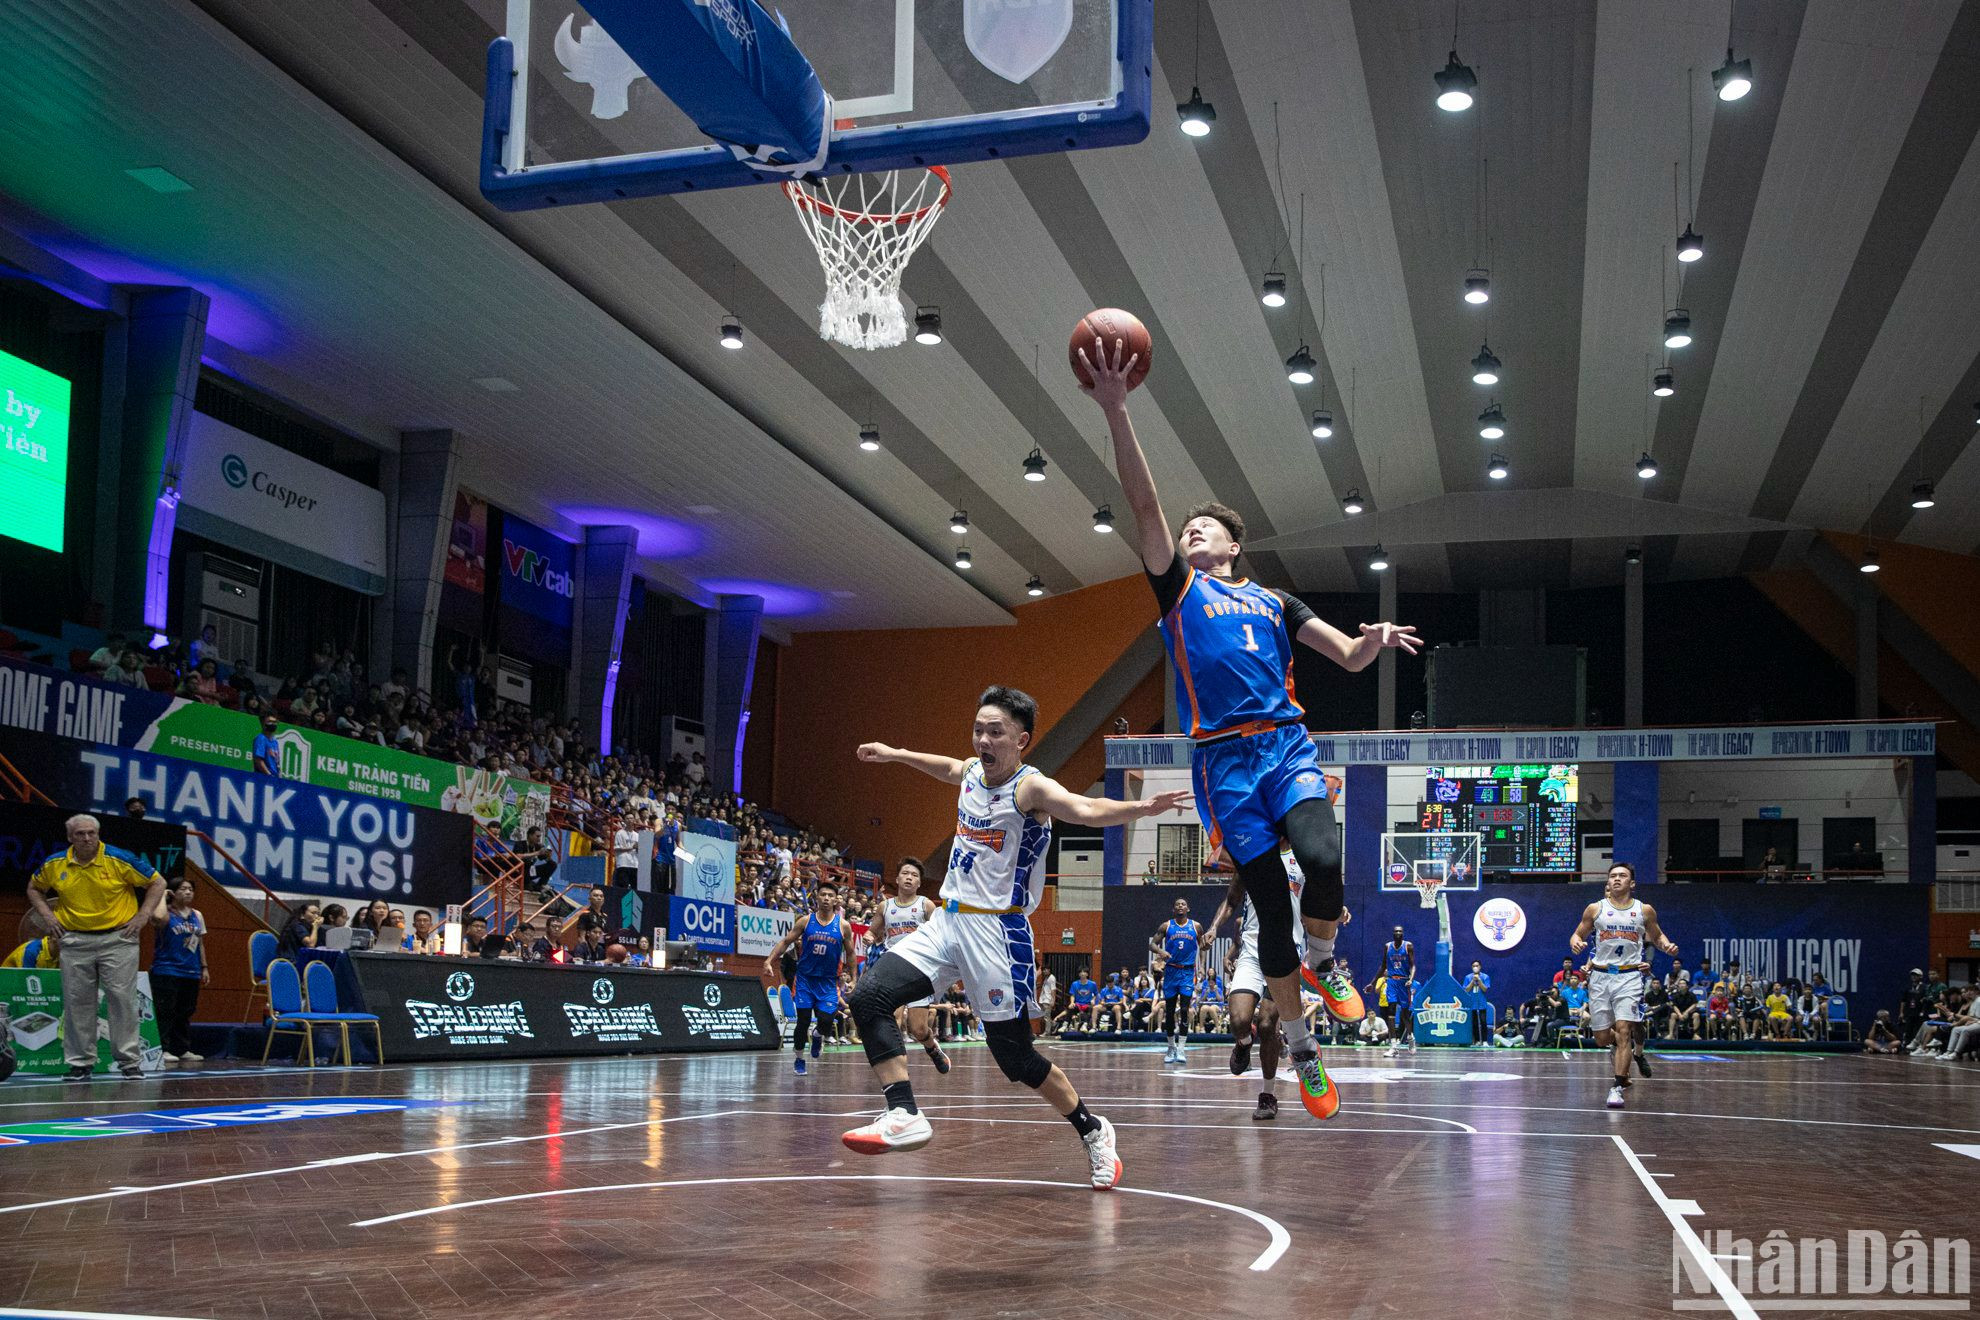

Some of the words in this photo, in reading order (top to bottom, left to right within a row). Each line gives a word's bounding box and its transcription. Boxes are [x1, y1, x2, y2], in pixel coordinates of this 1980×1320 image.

[711, 0, 754, 51] SPORT
[6, 389, 41, 428] by
[252, 471, 317, 511] Casper
[504, 538, 574, 598] VTVcab
[1242, 624, 1259, 651] 1
[57, 680, 126, 747] GAME
[171, 735, 242, 761] PRESENTED
[1315, 739, 1335, 761] OWN
[1348, 740, 1358, 761] THE
[1359, 739, 1379, 761] CAPITAL
[1381, 738, 1411, 761] LEGACY
[1427, 738, 1466, 761] REPRESENTING
[1468, 737, 1501, 760] H-TOWN
[1515, 737, 1525, 759] THE
[1526, 737, 1547, 759] CAPITAL
[1549, 735, 1580, 758] LEGACY
[1597, 735, 1637, 757] REPRESENTING
[1639, 734, 1673, 757] H-TOWN
[1687, 733, 1698, 756] THE
[1699, 732, 1720, 756] CAPITAL
[1722, 732, 1754, 755] LEGACY
[1771, 731, 1815, 754] REPRESENTING
[1815, 730, 1850, 754] H-TOWN
[1865, 729, 1877, 752] THE
[1877, 729, 1900, 752] CAPITAL
[1902, 728, 1936, 752] LEGACY
[1143, 742, 1174, 765] H-TOWN
[317, 755, 348, 776] KEM
[353, 762, 397, 786] TRÀNG
[402, 772, 431, 793] TIỀN
[81, 751, 297, 831] THANK
[318, 794, 415, 849] YOU
[348, 781, 378, 795] SINCE
[381, 787, 401, 800] 1958
[1510, 788, 1522, 802] 58
[968, 815, 993, 828] TRANG
[1421, 812, 1442, 828] 21
[140, 812, 414, 895] ARMERS!
[683, 902, 726, 935] OCH
[813, 943, 828, 956] 30
[1178, 940, 1185, 950] 3
[1614, 945, 1624, 957] 4
[1702, 938, 1726, 979] THE
[1786, 938, 1862, 993] LEGACY
[405, 999, 535, 1039] SPALDING
[563, 1002, 662, 1037] SPALDING
[681, 1004, 761, 1036] SPALDING
[1419, 1010, 1467, 1022] BUFFALOES
